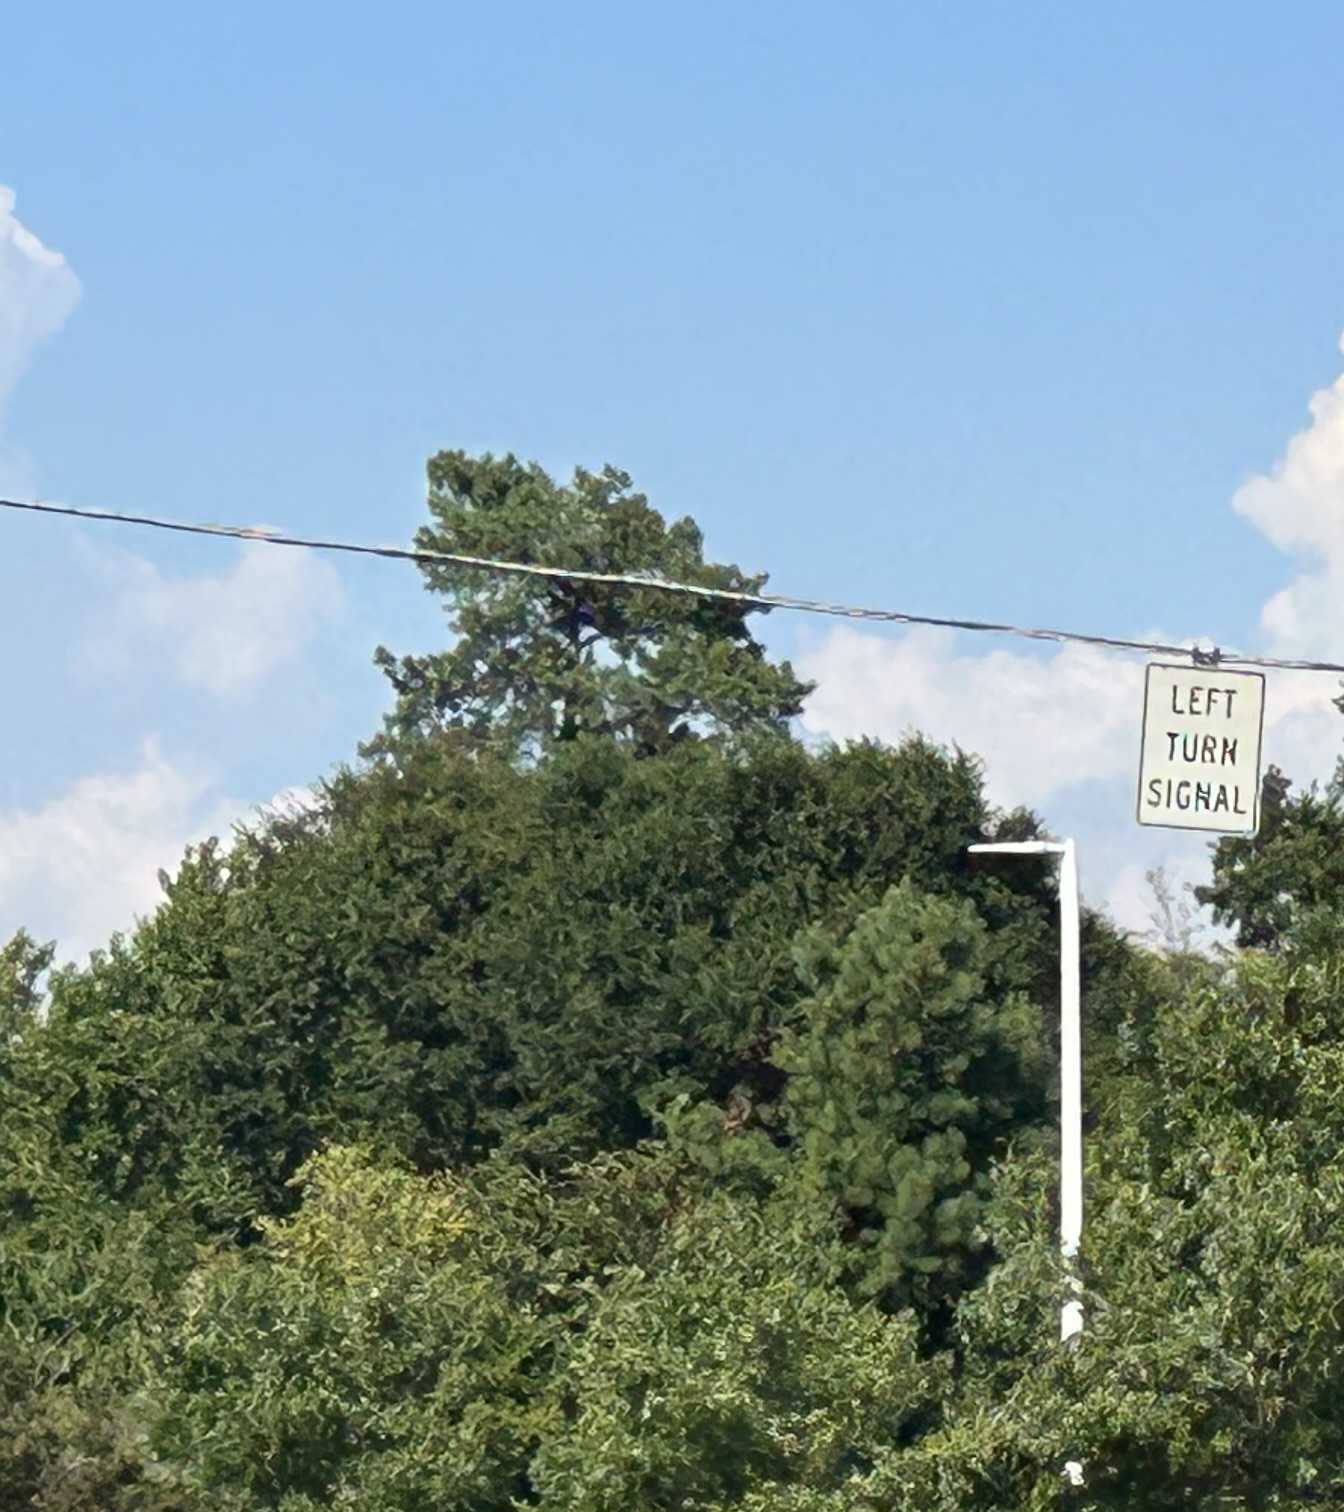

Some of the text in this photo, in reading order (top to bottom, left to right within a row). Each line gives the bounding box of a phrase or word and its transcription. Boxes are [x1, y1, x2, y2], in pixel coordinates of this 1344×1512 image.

[1172, 684, 1238, 718] LEFT
[1166, 731, 1238, 766] TURN
[1147, 778, 1247, 814] SIGNAL
